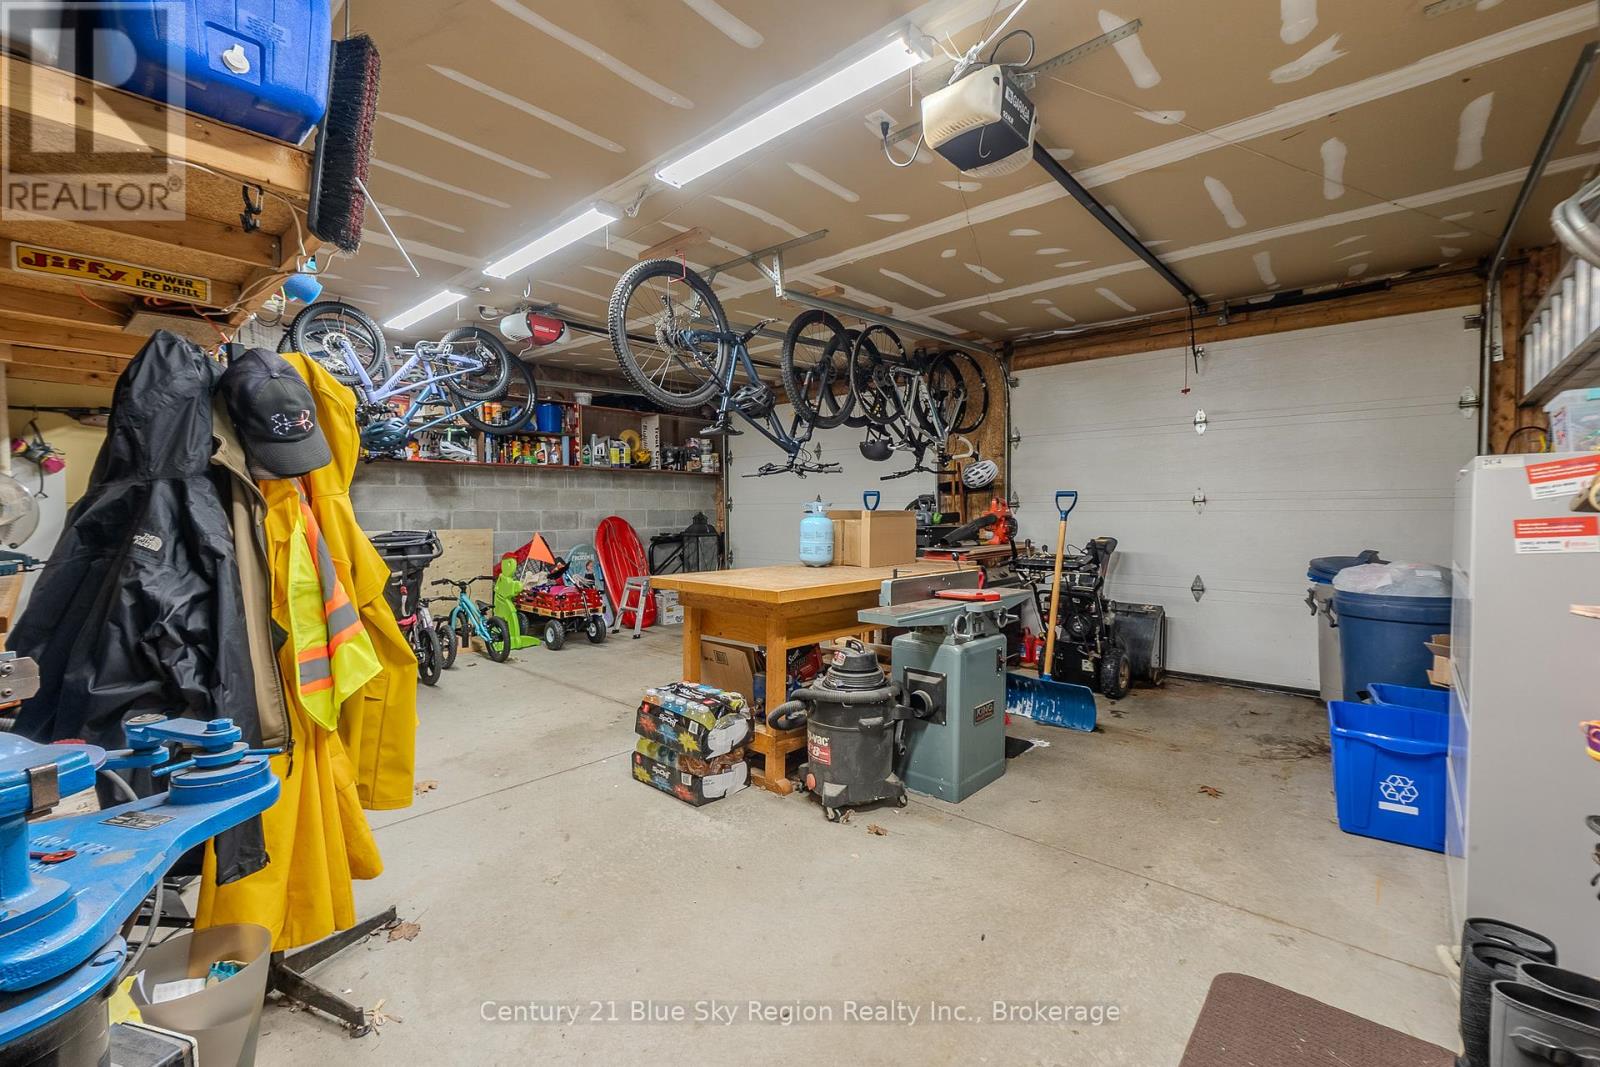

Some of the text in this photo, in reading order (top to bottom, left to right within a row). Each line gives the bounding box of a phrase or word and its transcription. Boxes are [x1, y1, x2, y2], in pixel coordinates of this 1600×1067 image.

[21, 251, 128, 282] Jiffy
[135, 278, 201, 298] ICE DRILL
[142, 271, 194, 289] POWER
